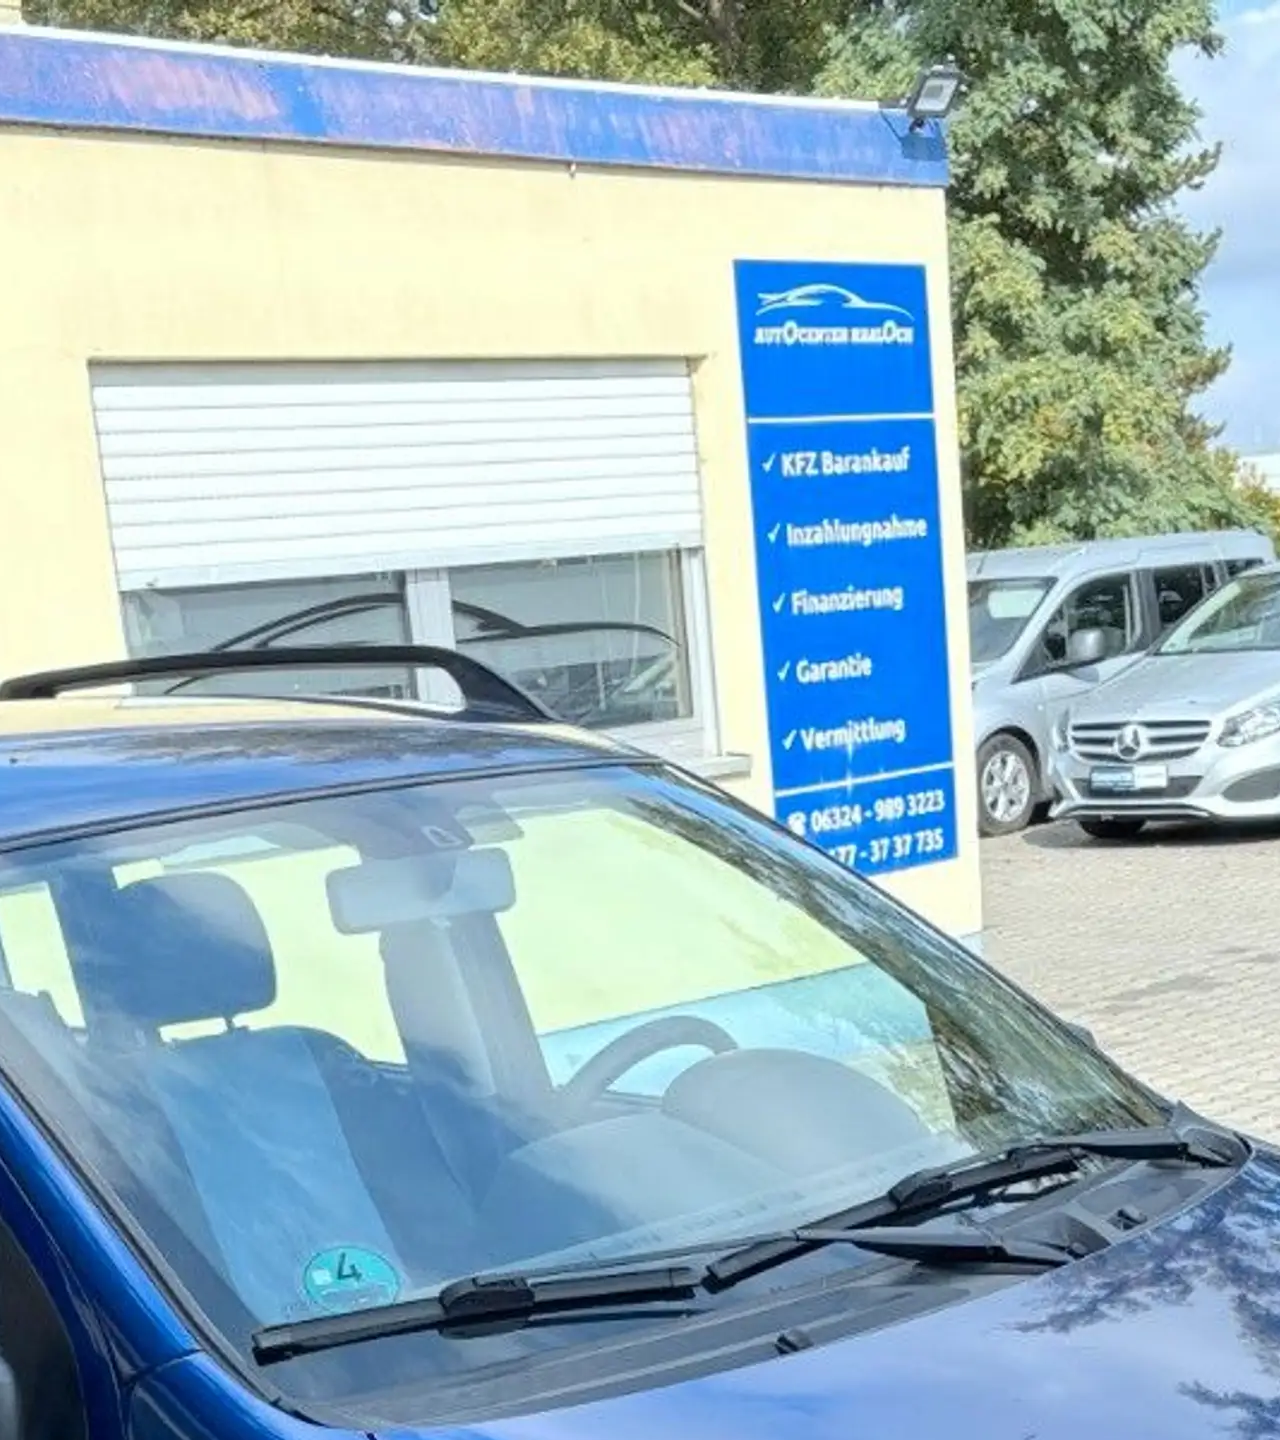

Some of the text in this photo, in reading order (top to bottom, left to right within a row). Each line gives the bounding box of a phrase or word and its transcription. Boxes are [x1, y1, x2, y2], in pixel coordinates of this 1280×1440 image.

[781, 447, 910, 476] KFZ Barankauf
[786, 513, 927, 546] Inzahlungnahme
[791, 584, 904, 615] Finanzierung
[796, 653, 871, 683] Garantie
[801, 718, 906, 750] Vermittlung
[811, 804, 862, 832] 06324
[907, 789, 946, 816] 3223
[869, 837, 890, 863] 37
[892, 833, 912, 858] 37
[915, 828, 944, 853] 735
[337, 1252, 363, 1283] 4
